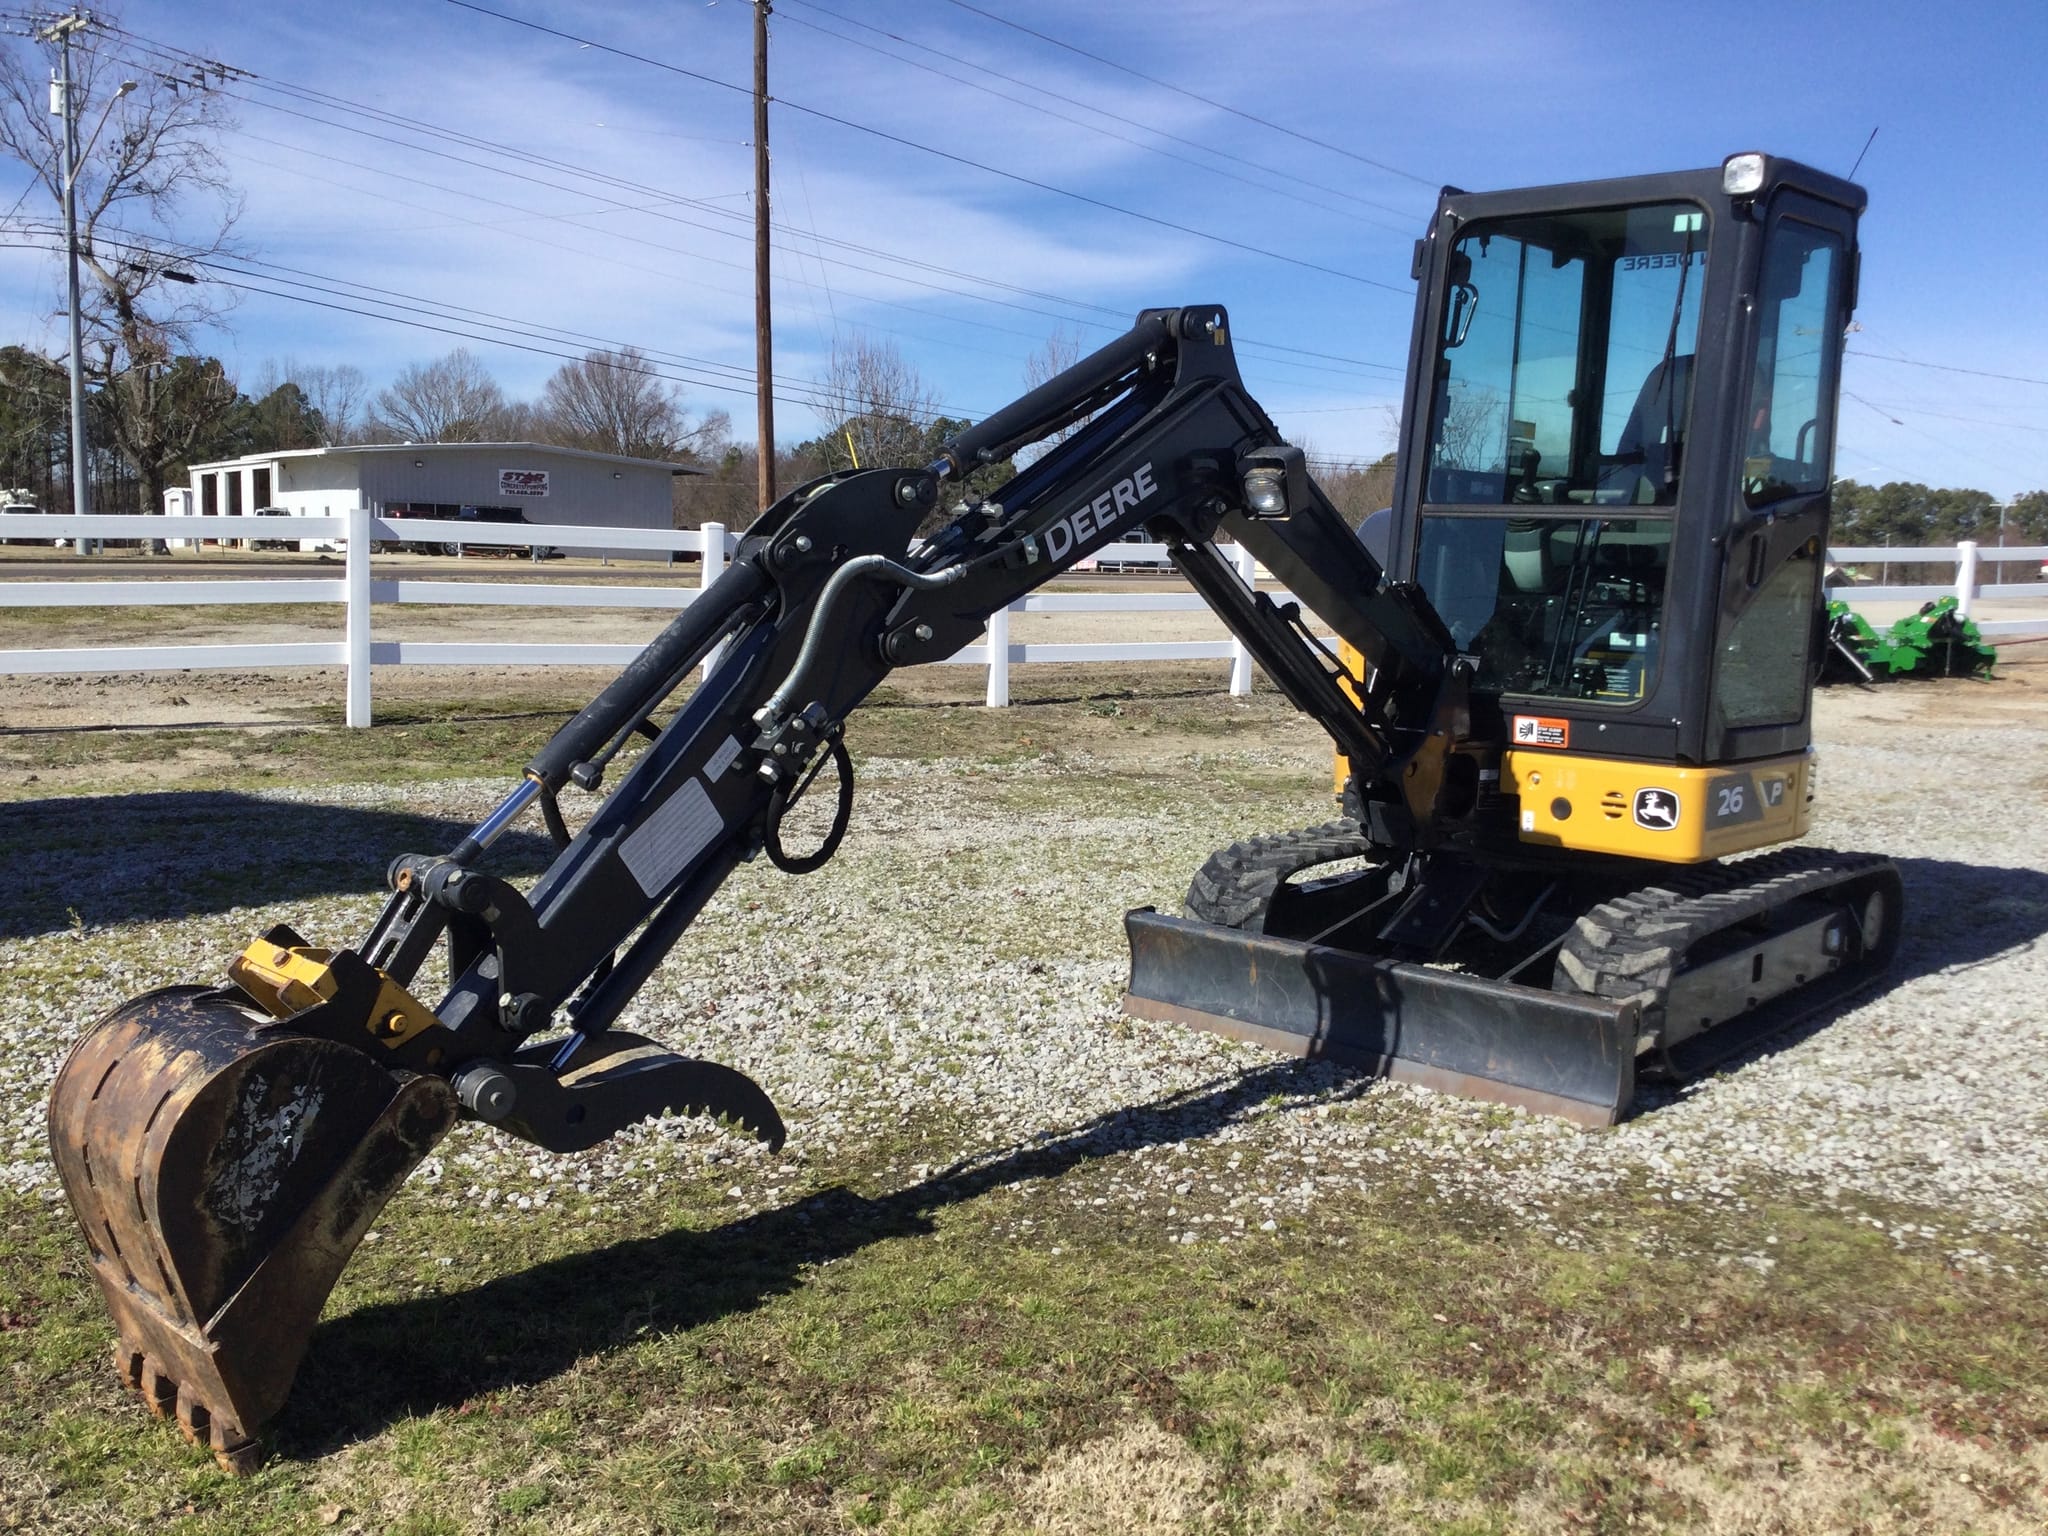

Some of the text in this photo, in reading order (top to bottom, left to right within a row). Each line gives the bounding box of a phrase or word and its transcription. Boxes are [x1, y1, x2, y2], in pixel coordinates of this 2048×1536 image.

[502, 472, 545, 484] STAR
[1044, 462, 1158, 562] DEERE
[1717, 786, 1744, 816] 26
